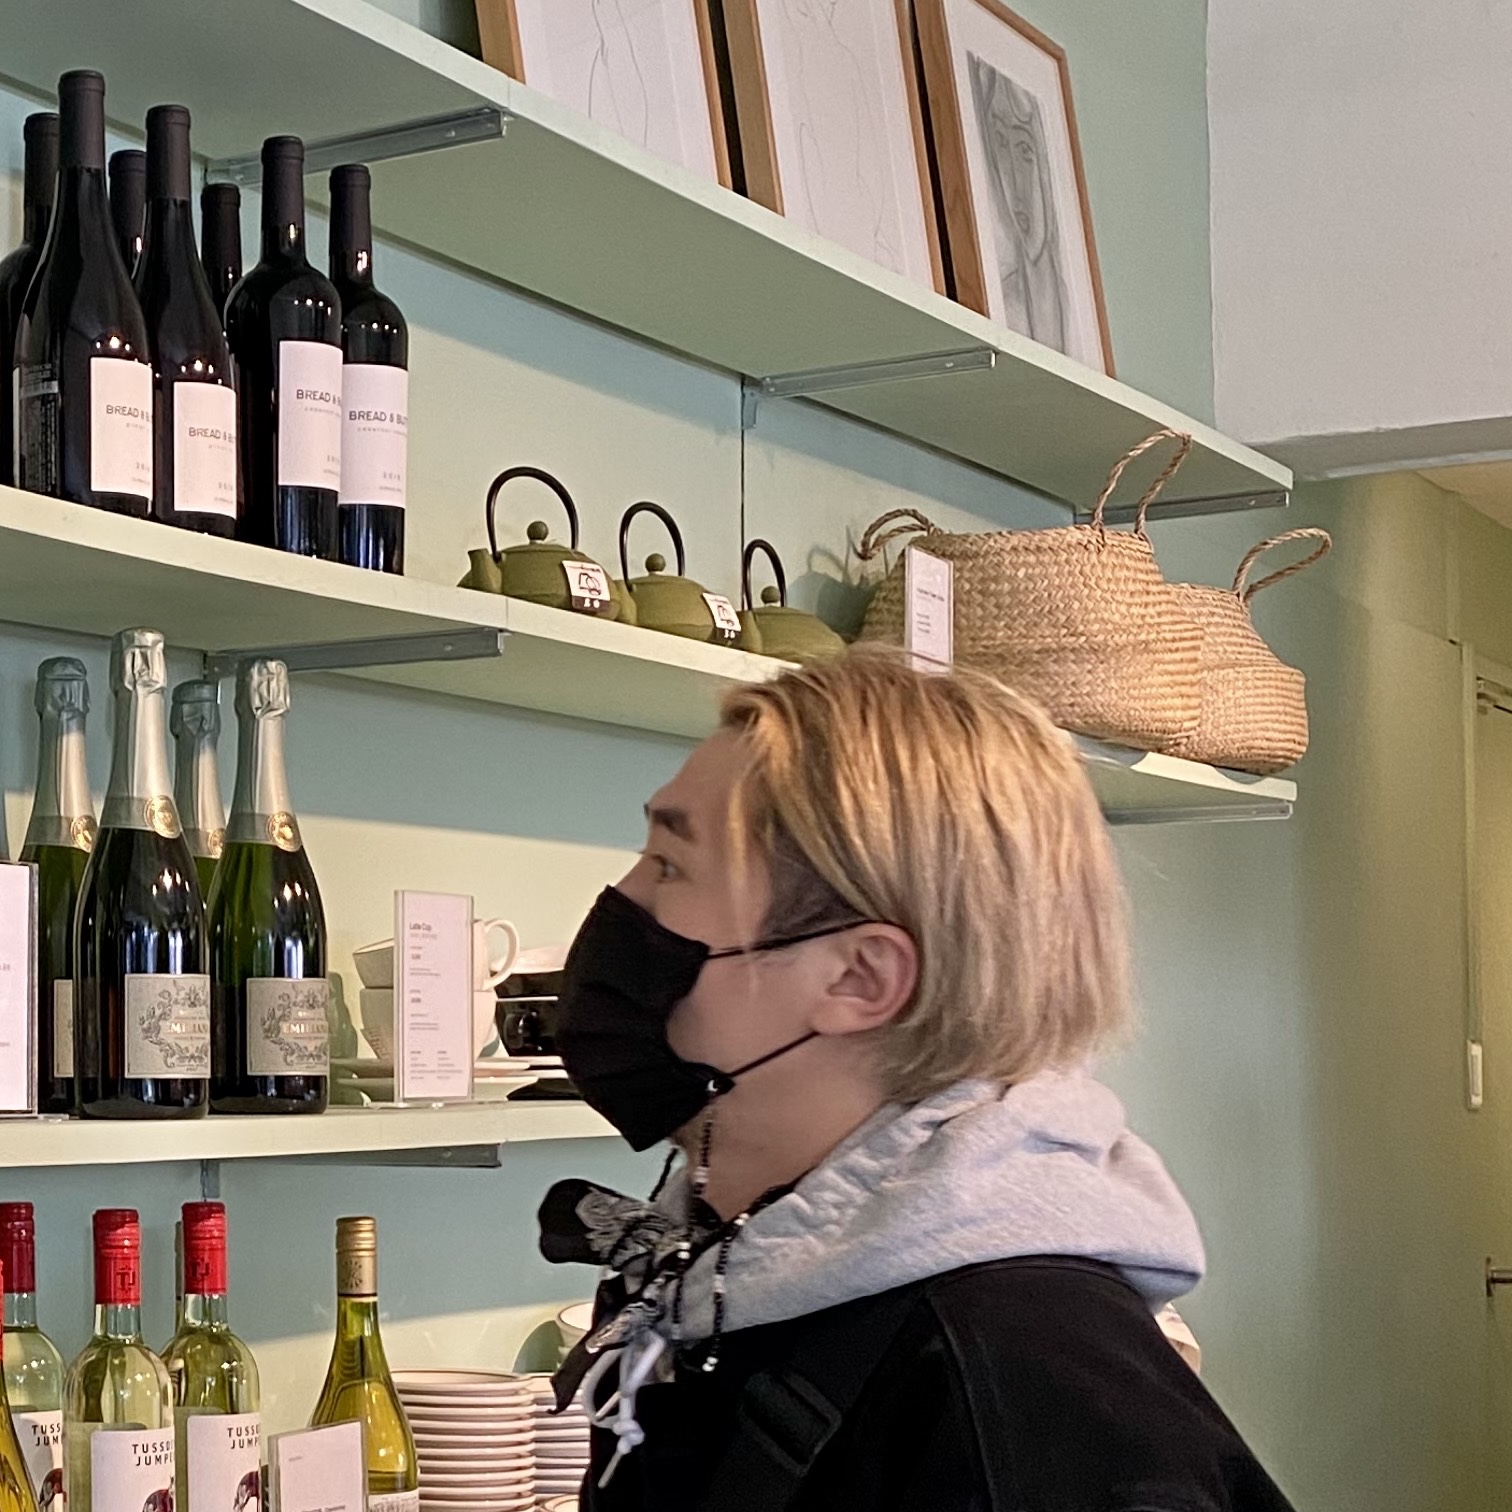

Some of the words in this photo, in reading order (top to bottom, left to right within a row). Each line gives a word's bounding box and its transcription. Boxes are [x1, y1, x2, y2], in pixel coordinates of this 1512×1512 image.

[296, 389, 331, 403] BREAD
[105, 404, 139, 419] BREAD
[348, 409, 386, 423] BREAD
[188, 427, 221, 440] BREAD
